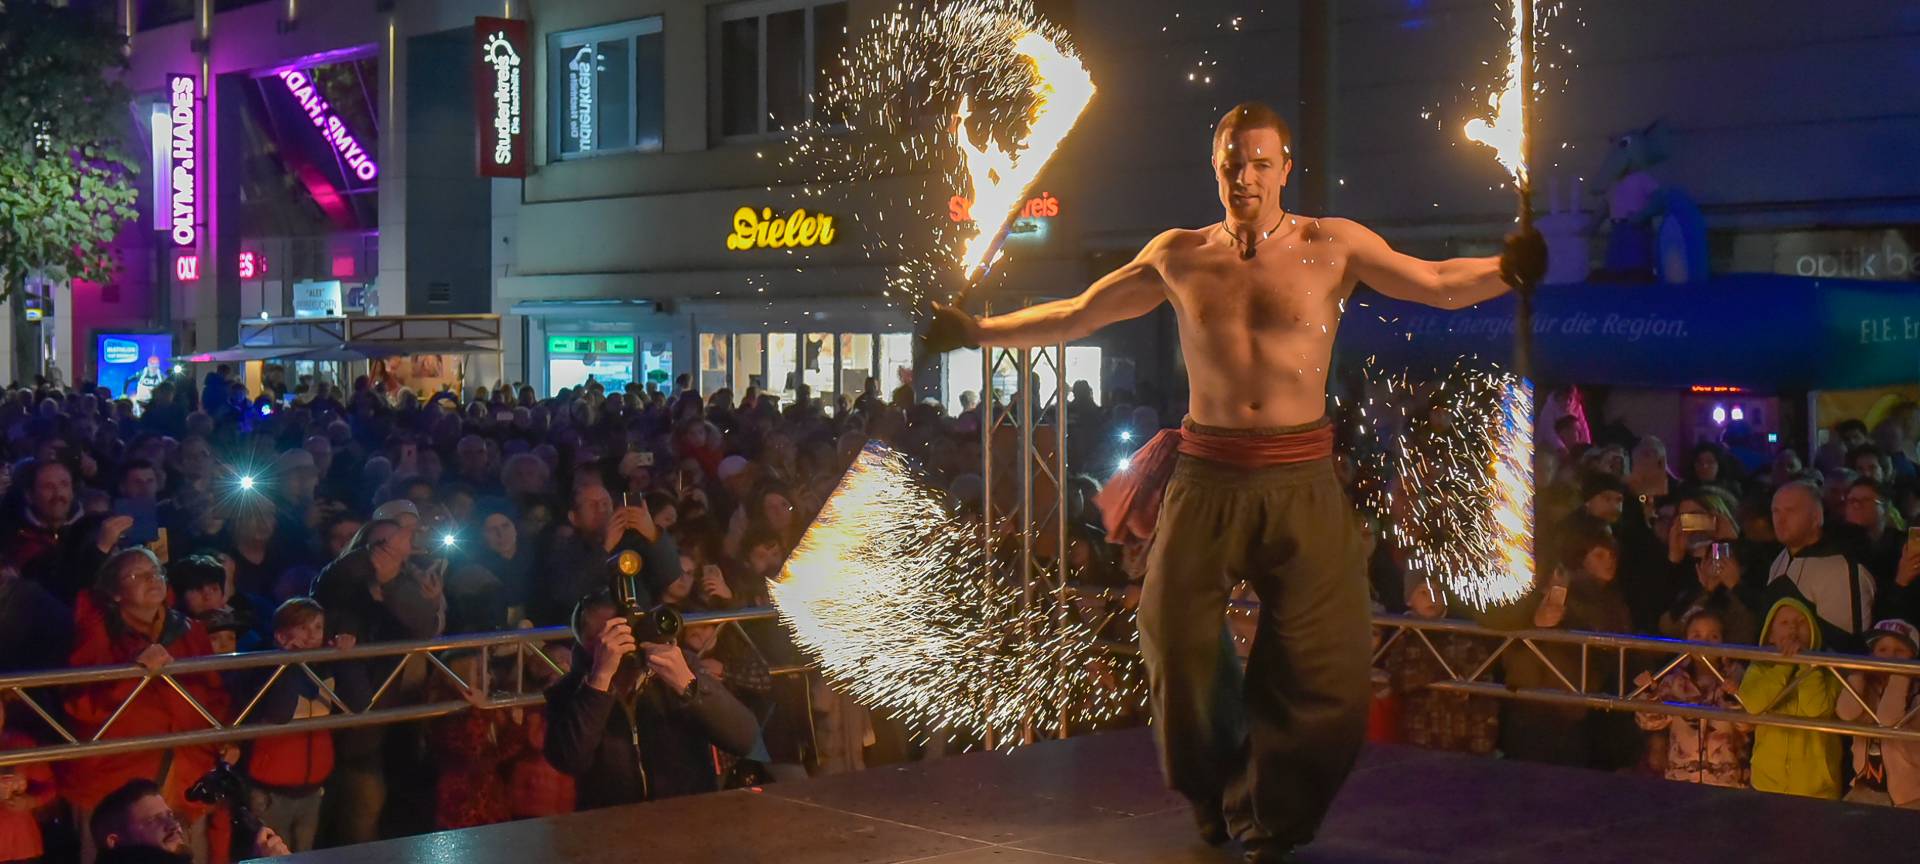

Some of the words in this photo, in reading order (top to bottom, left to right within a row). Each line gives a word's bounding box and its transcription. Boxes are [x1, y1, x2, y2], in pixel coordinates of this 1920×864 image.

[494, 55, 512, 164] Studienkreis
[511, 68, 520, 115] Nachhilfe
[511, 116, 520, 134] Die
[727, 206, 836, 250] Dieler
[1796, 246, 1876, 277] optik
[1561, 312, 1597, 334] die
[1602, 314, 1689, 341] Region.
